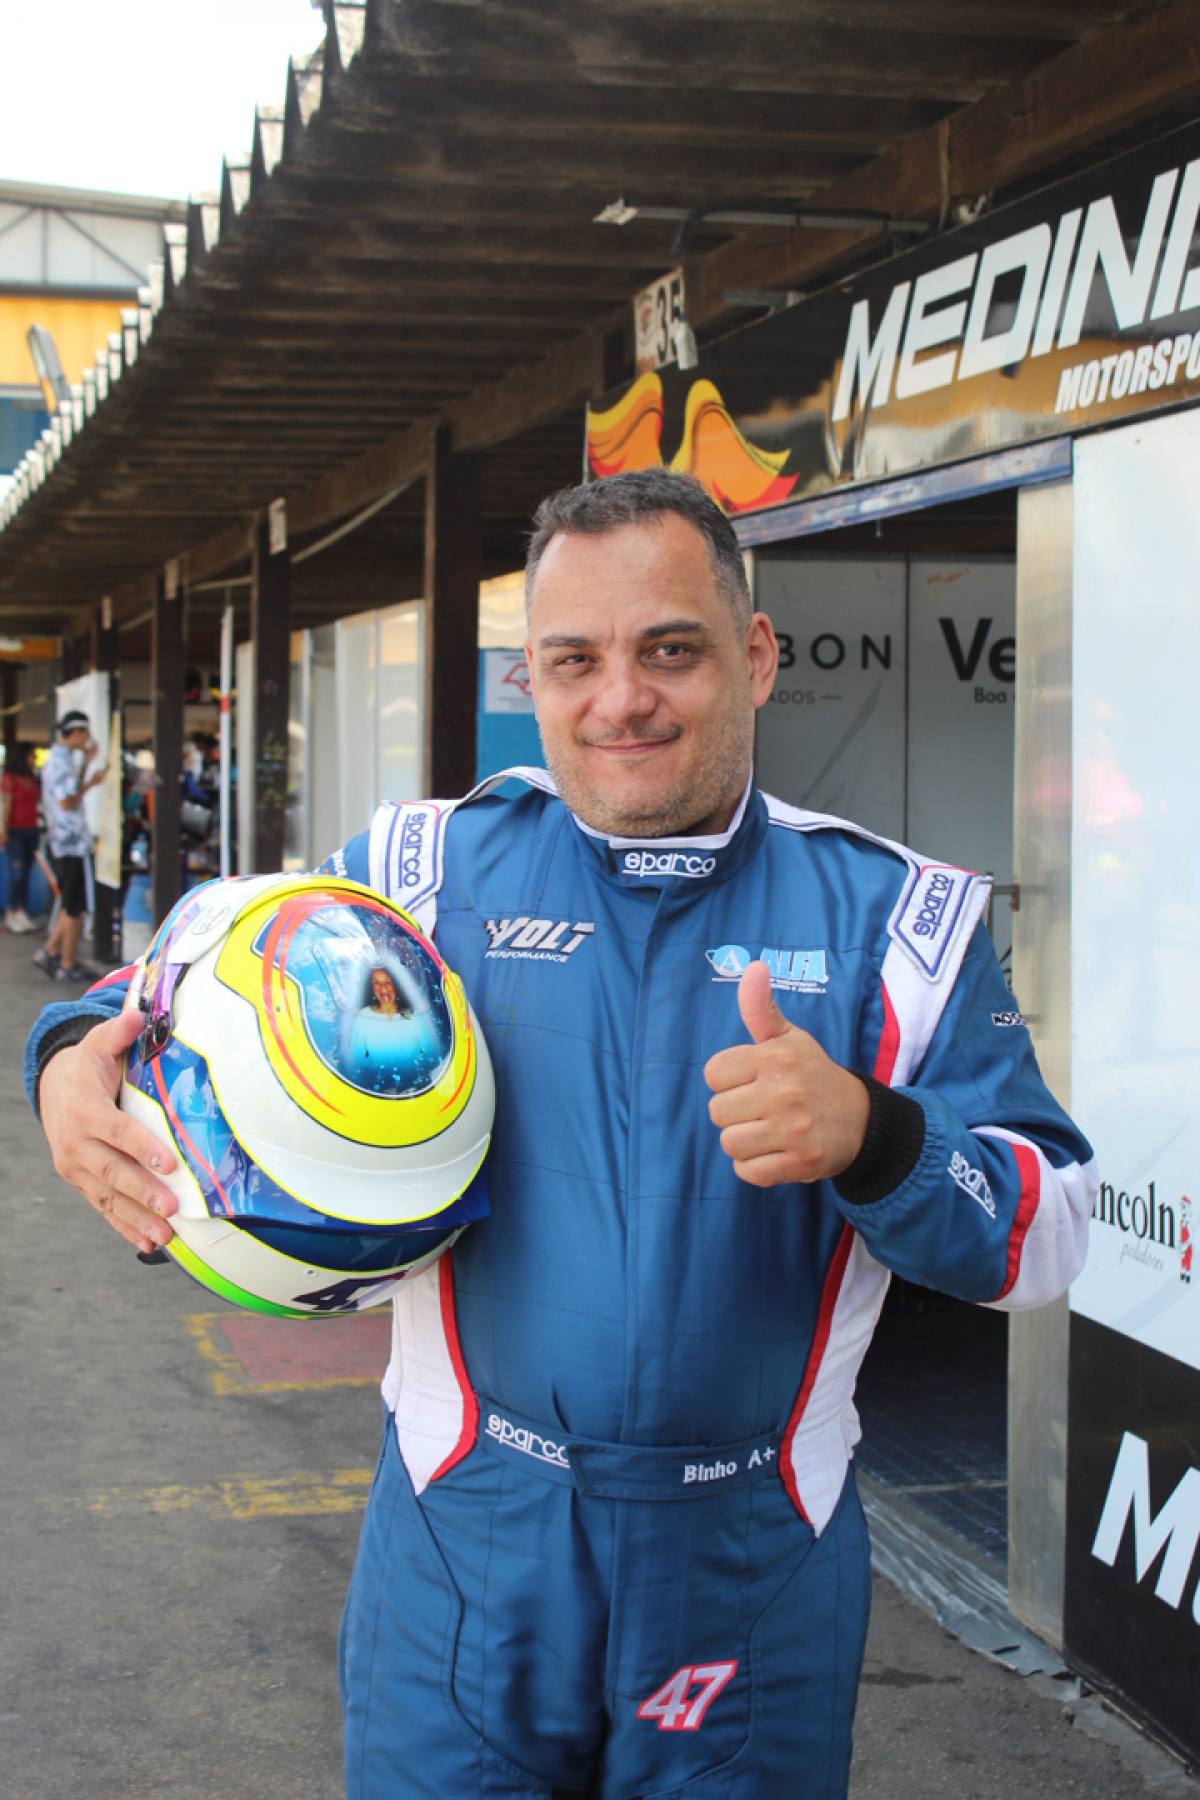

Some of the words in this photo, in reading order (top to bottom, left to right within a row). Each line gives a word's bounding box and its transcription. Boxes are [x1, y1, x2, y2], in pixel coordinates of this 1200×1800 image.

[403, 812, 427, 887] sparco
[624, 851, 716, 878] sparco
[913, 872, 949, 939] sparco
[484, 917, 595, 954] VOLT
[484, 949, 570, 963] PERFORMANCE
[748, 1445, 776, 1470] A+
[638, 1660, 738, 1731] 47
